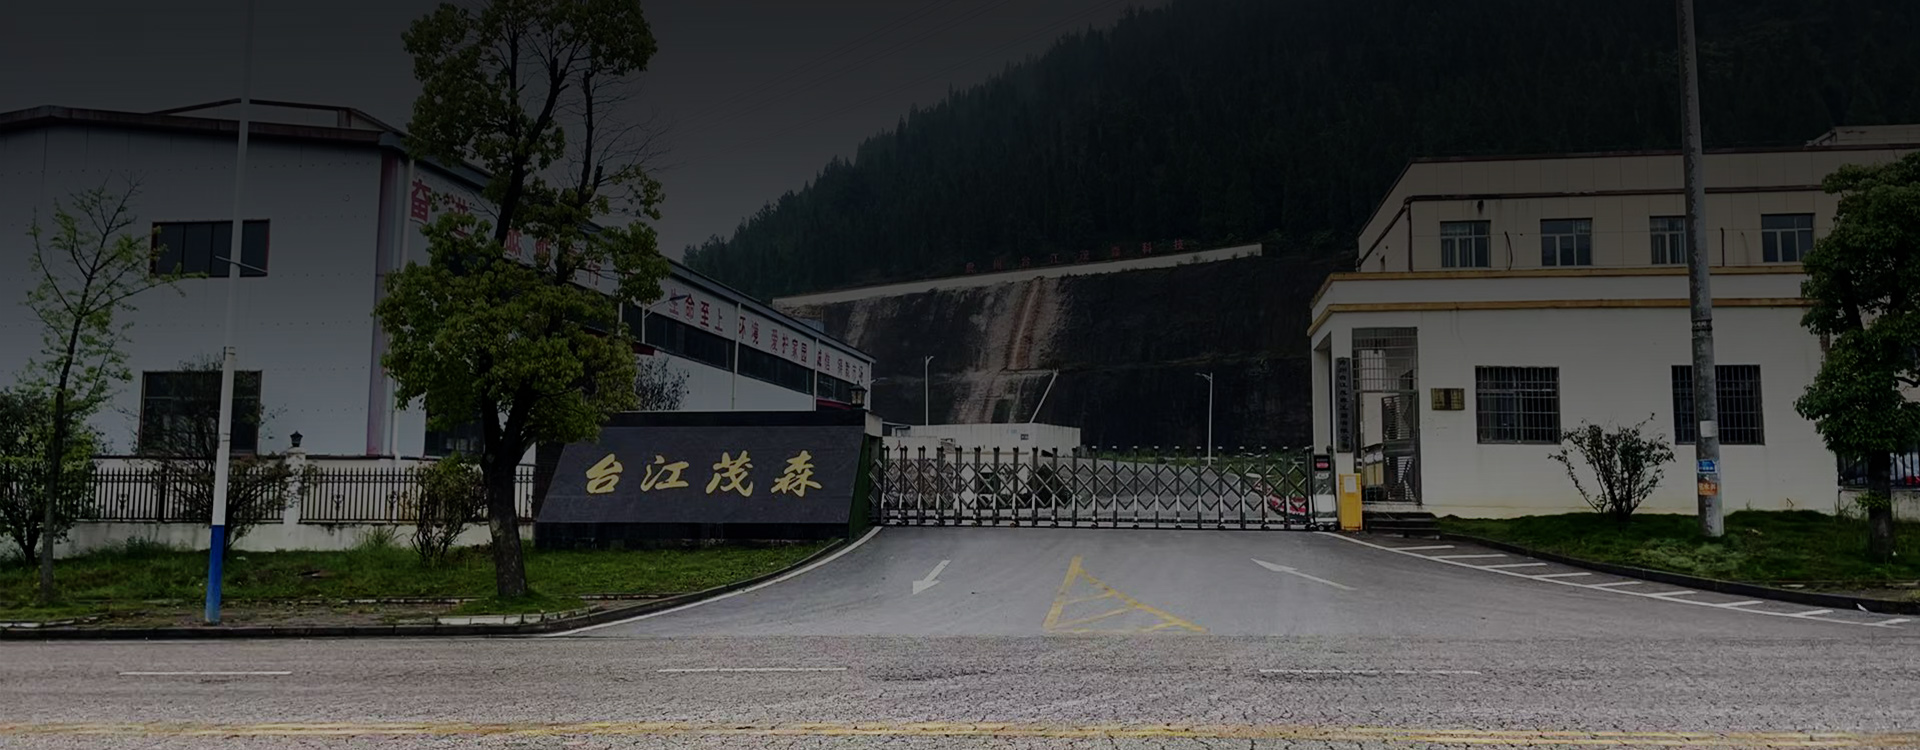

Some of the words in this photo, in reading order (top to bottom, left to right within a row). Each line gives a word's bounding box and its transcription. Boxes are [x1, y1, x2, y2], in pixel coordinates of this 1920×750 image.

[669, 288, 723, 332] 生命至上
[585, 451, 823, 497] 台江茂森
